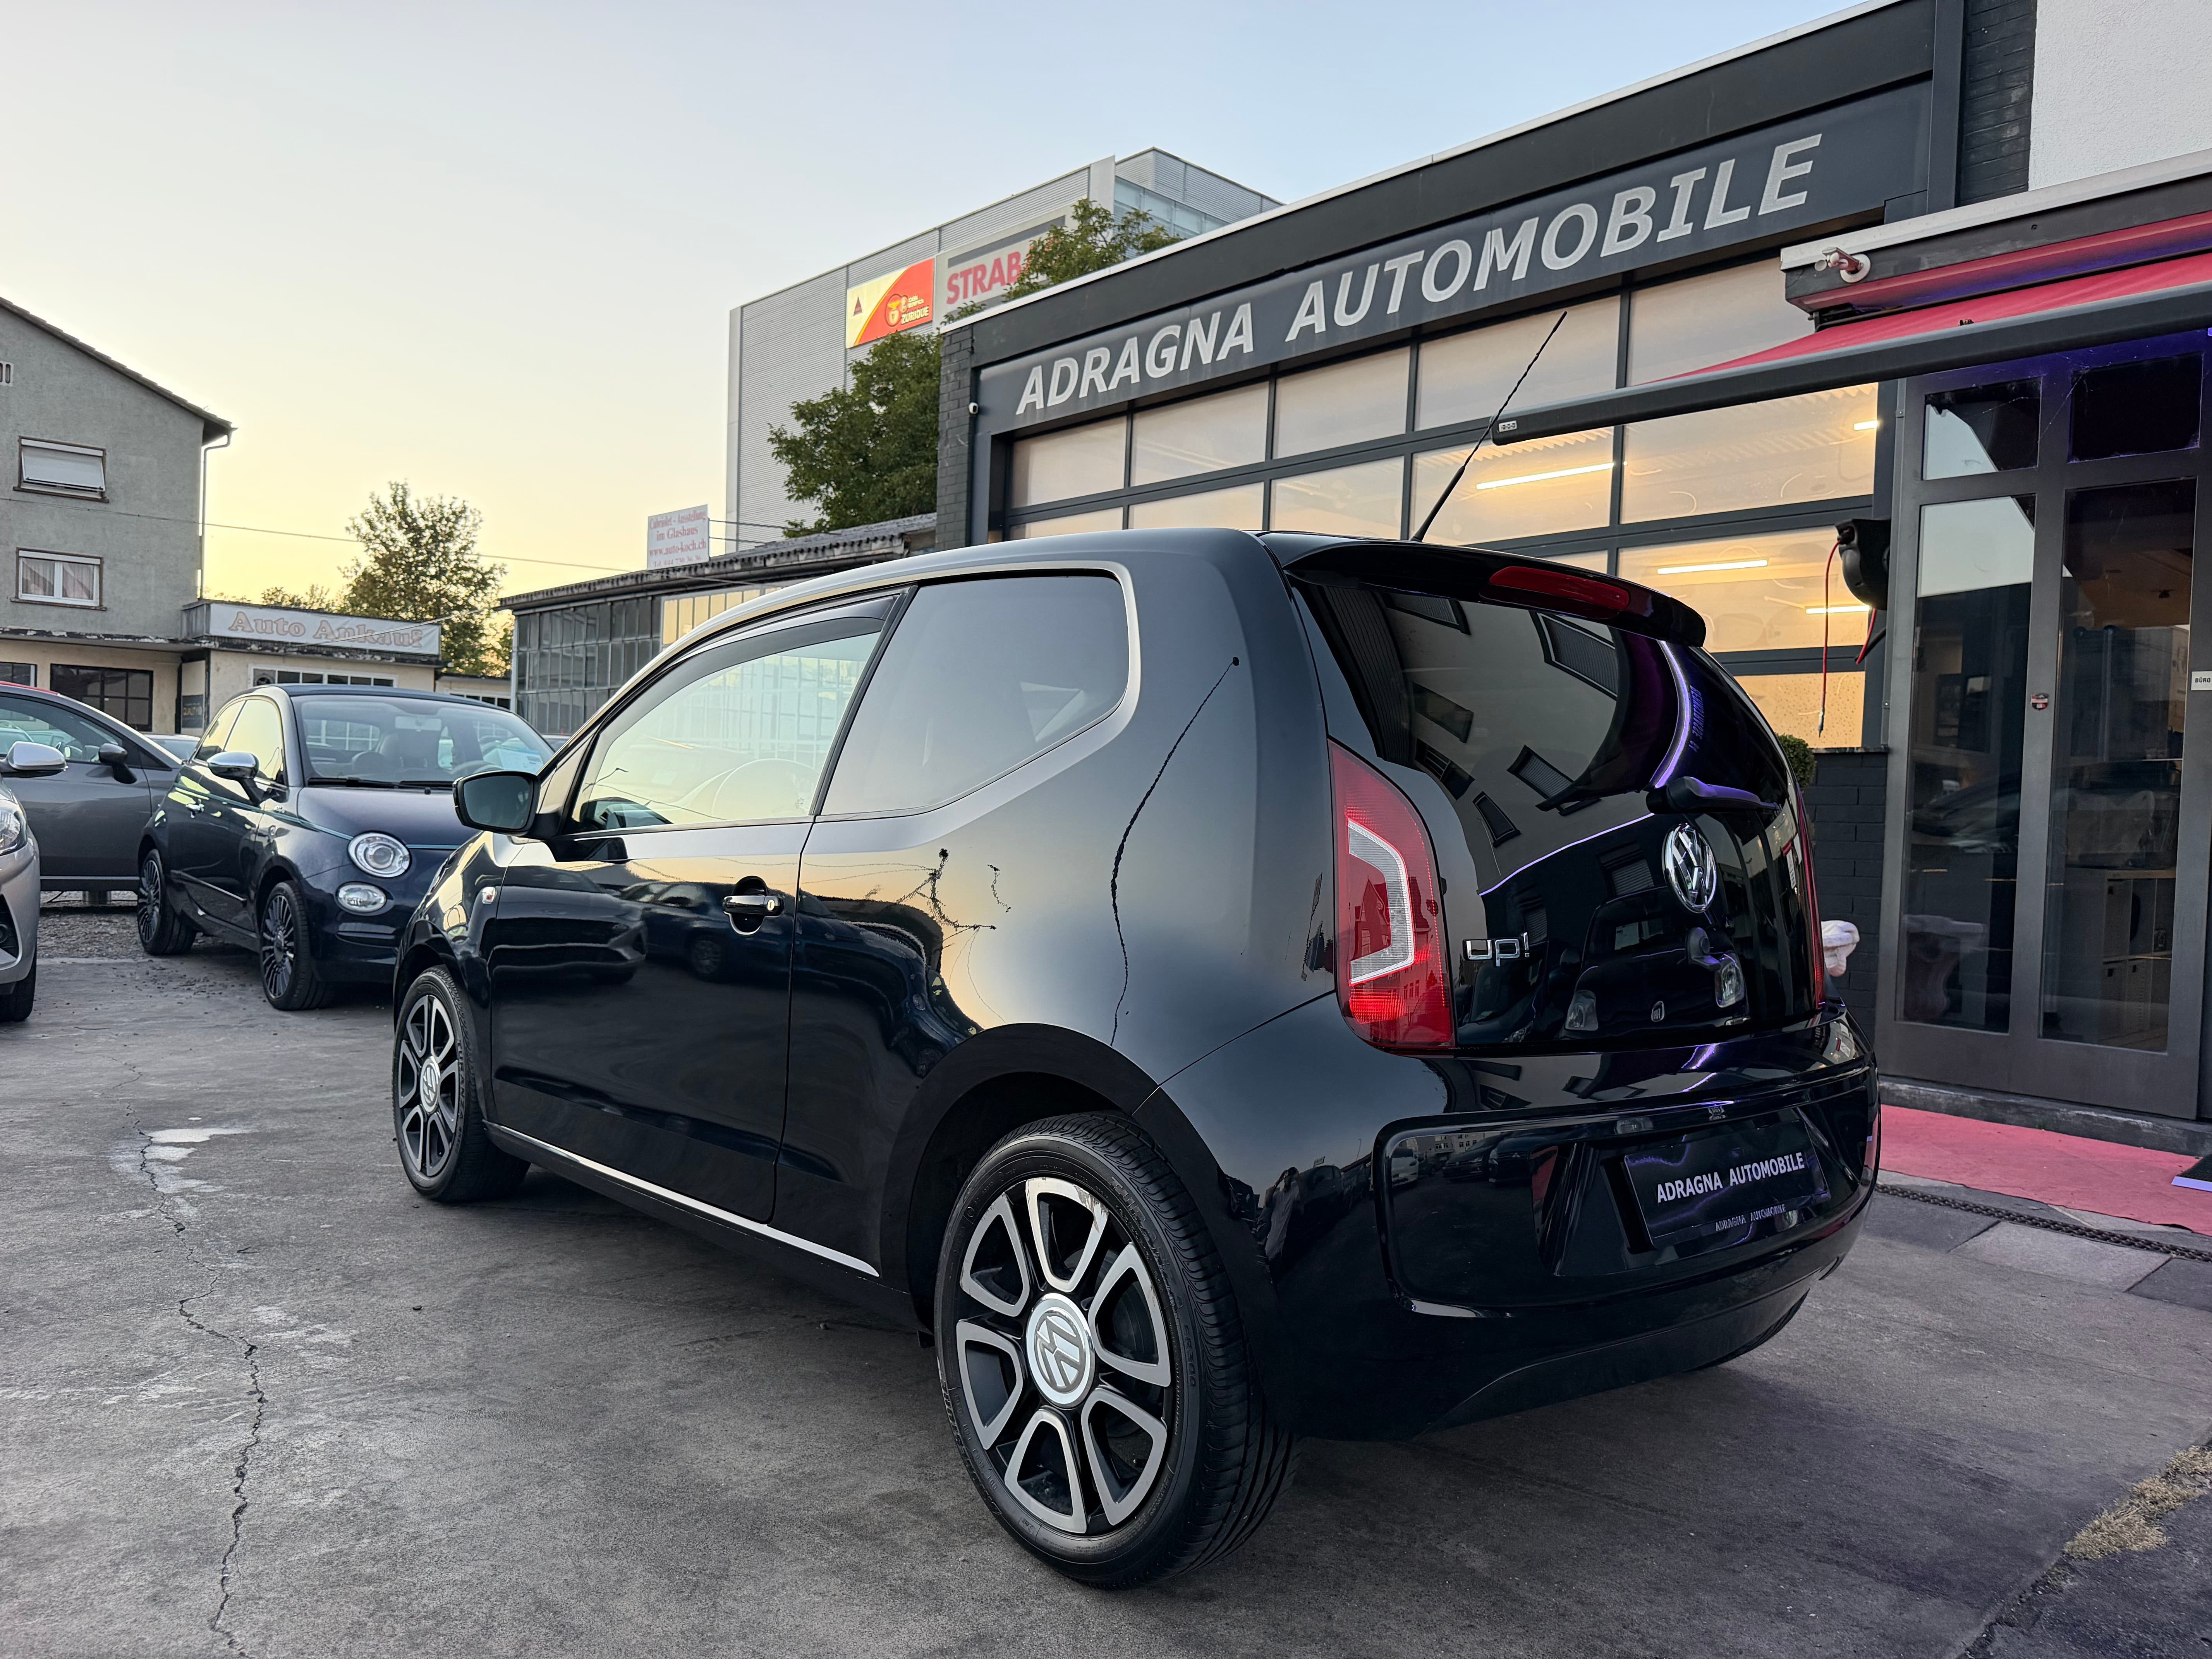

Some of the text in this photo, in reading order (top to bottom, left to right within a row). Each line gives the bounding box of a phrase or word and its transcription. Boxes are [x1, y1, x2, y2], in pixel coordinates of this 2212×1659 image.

[1015, 133, 1822, 415] ADRAGNA AUTOMOBILE
[900, 305, 930, 324] ZURIQUE
[649, 538, 706, 557] www.auto-koch.ch
[657, 526, 699, 541] im Glashaus
[228, 611, 424, 649] Auto Ankauf
[1463, 933, 1529, 967] up!
[1657, 1152, 1805, 1203] ADRAGNA AUTOMOBILE
[1715, 1204, 1786, 1232] ADRAGNA AUTOMOBILE
